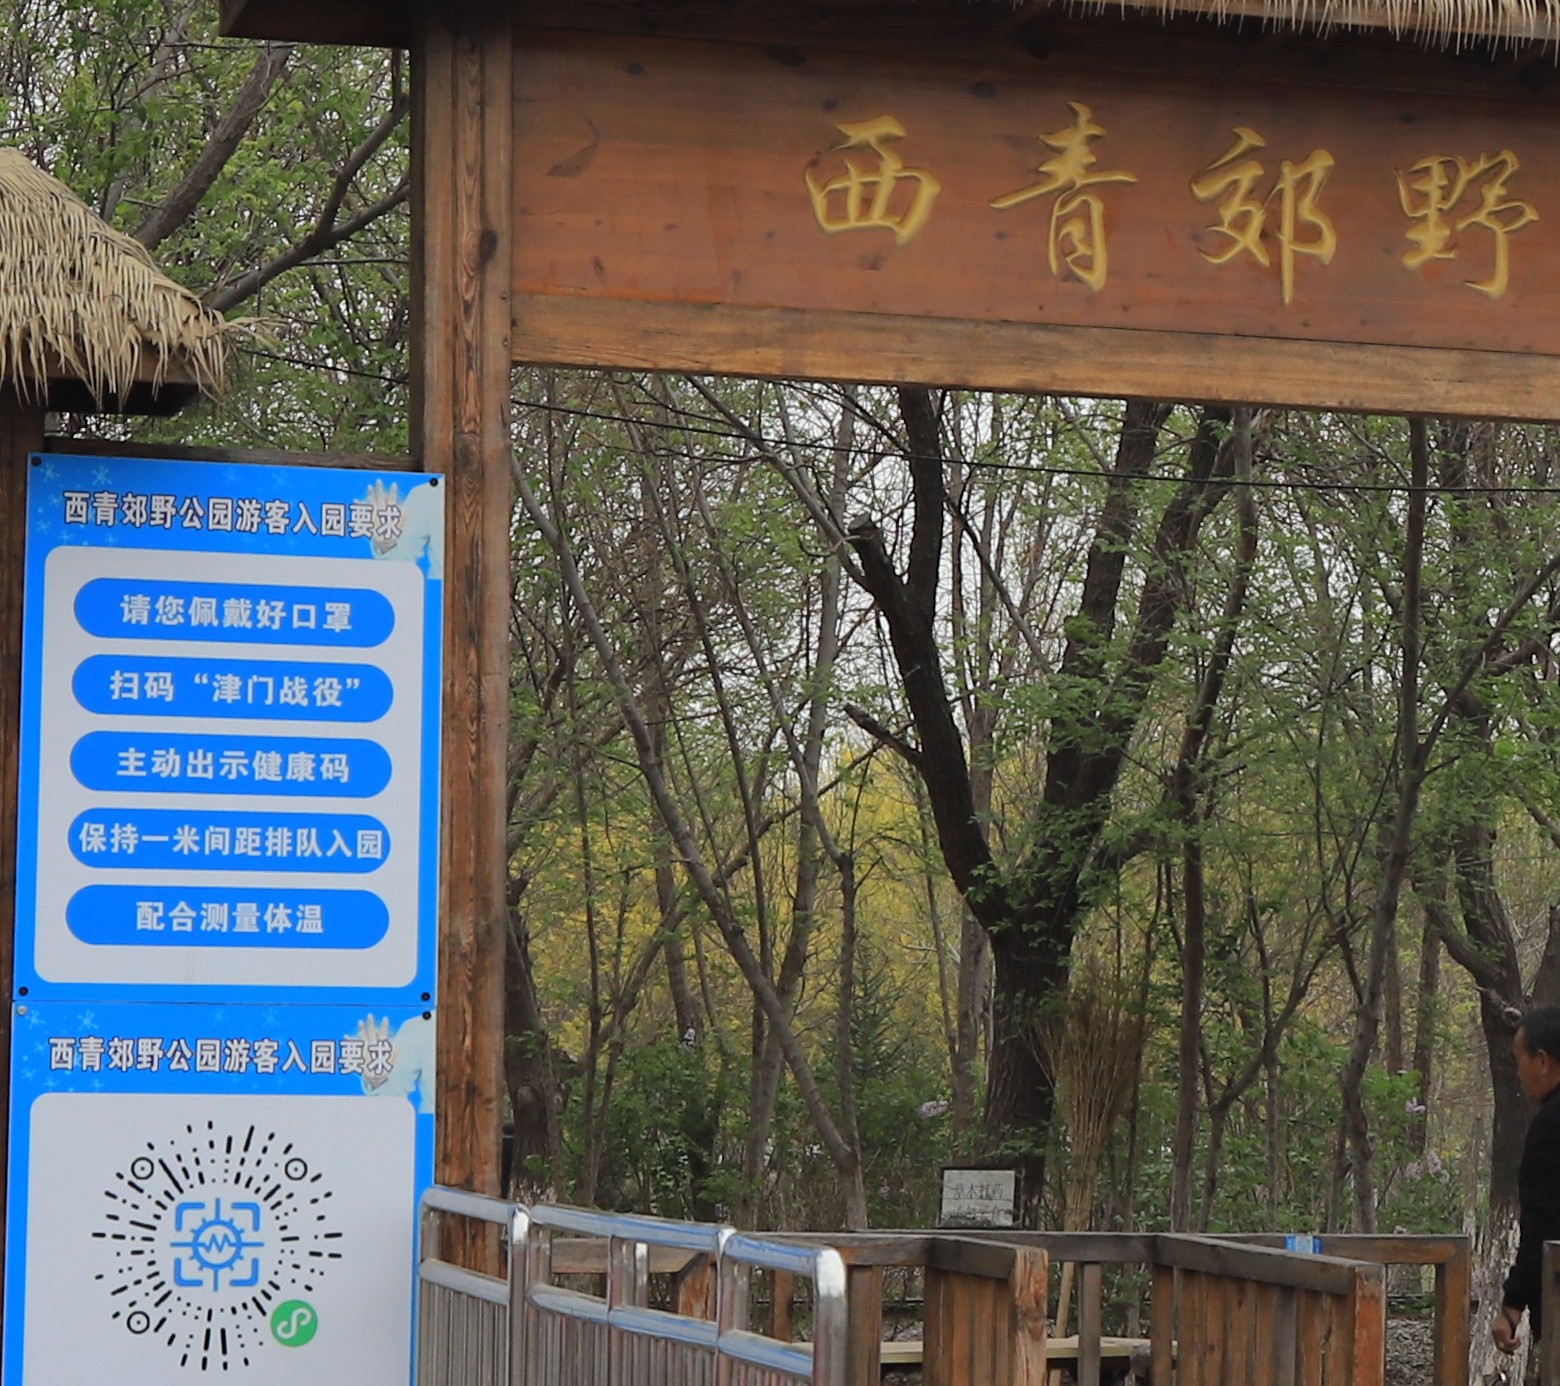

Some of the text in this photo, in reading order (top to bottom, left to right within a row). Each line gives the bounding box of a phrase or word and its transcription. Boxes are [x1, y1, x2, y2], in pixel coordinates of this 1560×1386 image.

[63, 490, 402, 540] 西青郊野公园游客入园要求
[120, 594, 353, 632] 请您佩戴好口罩
[117, 748, 349, 782] 主动出示健康码
[79, 822, 383, 859] 保持一米间距排队入园
[136, 901, 324, 934] 配合测量体温
[49, 1036, 394, 1074] 西青郊野公园游客入园要求
